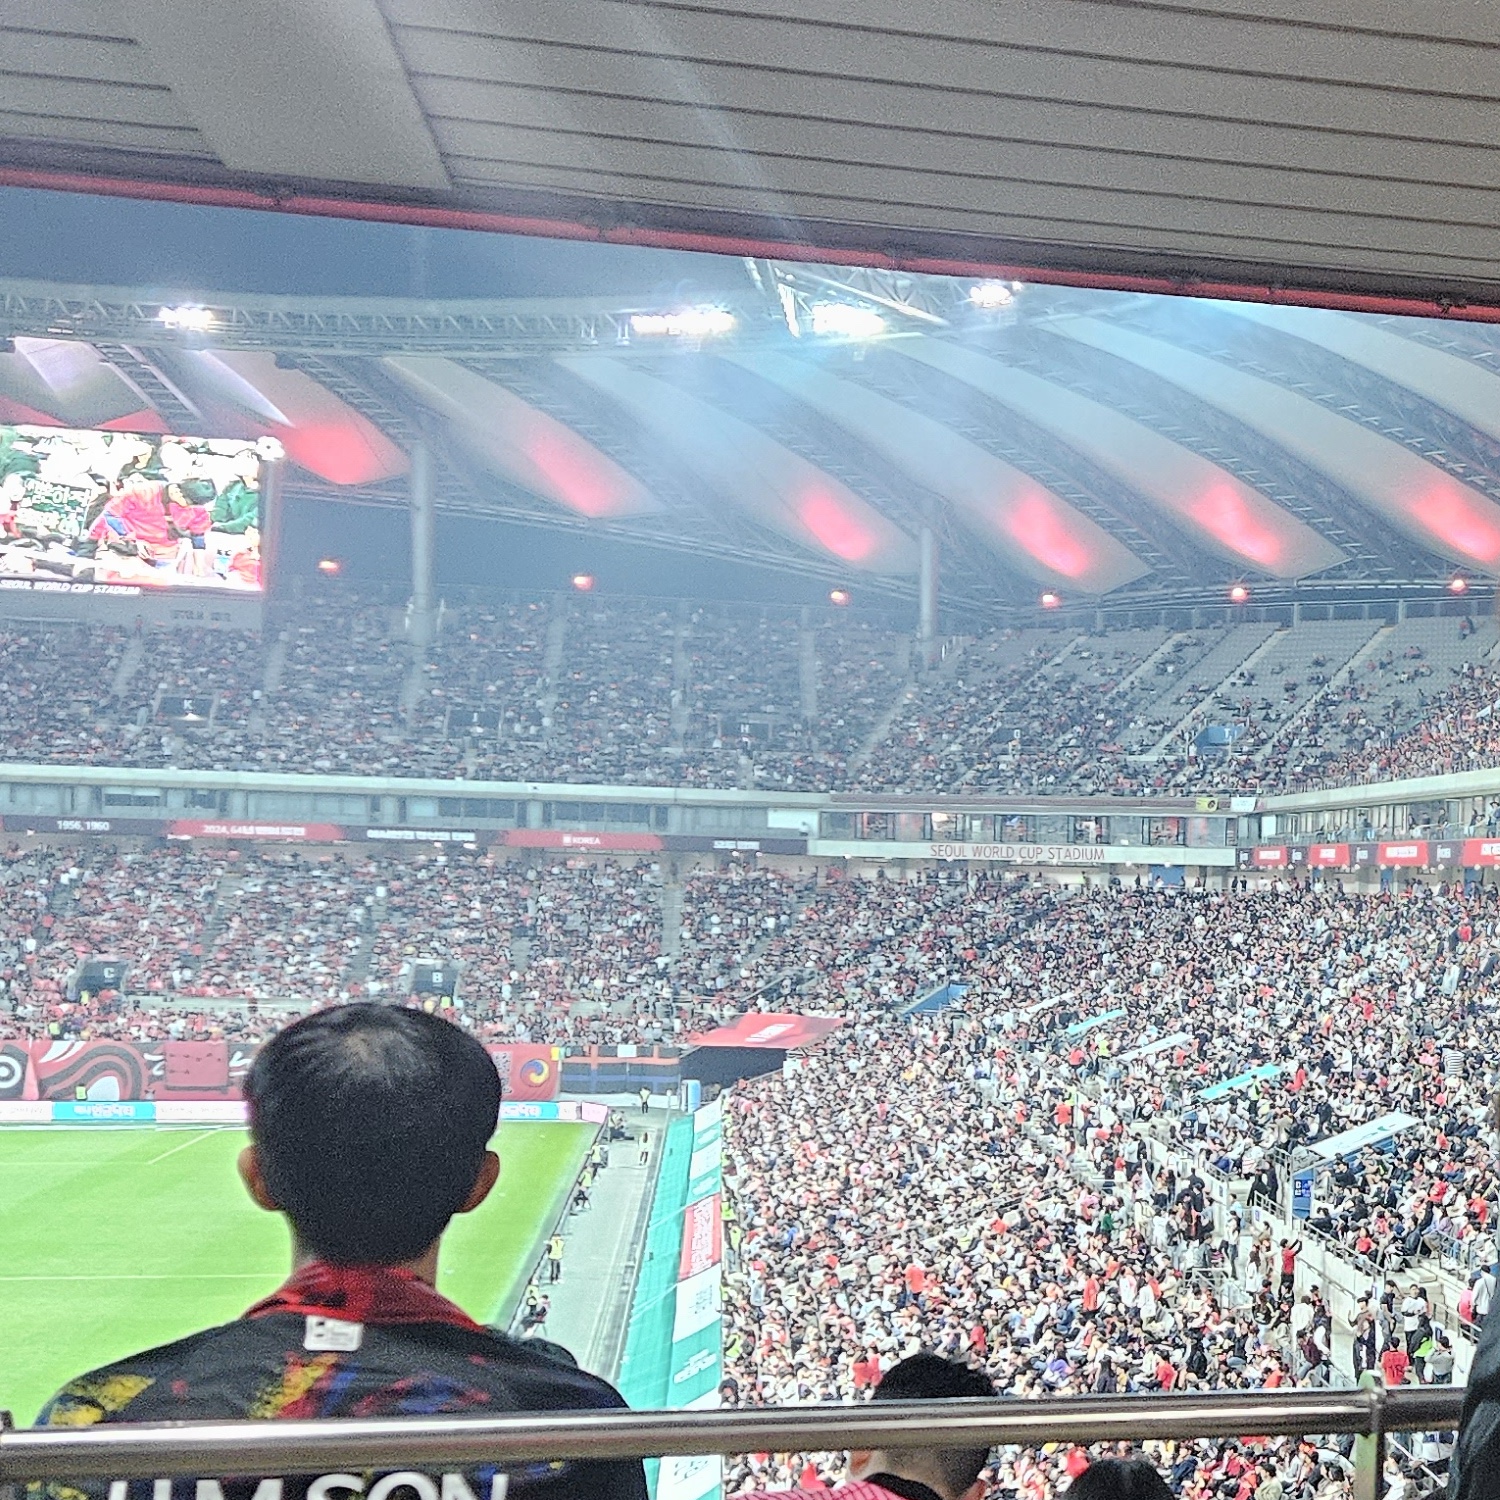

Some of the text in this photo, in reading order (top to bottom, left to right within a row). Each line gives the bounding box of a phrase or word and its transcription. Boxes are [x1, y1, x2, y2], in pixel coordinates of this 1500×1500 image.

[572, 837, 601, 846] KOREA
[930, 844, 1105, 861] SEOUL WORLD CUP STADIUM
